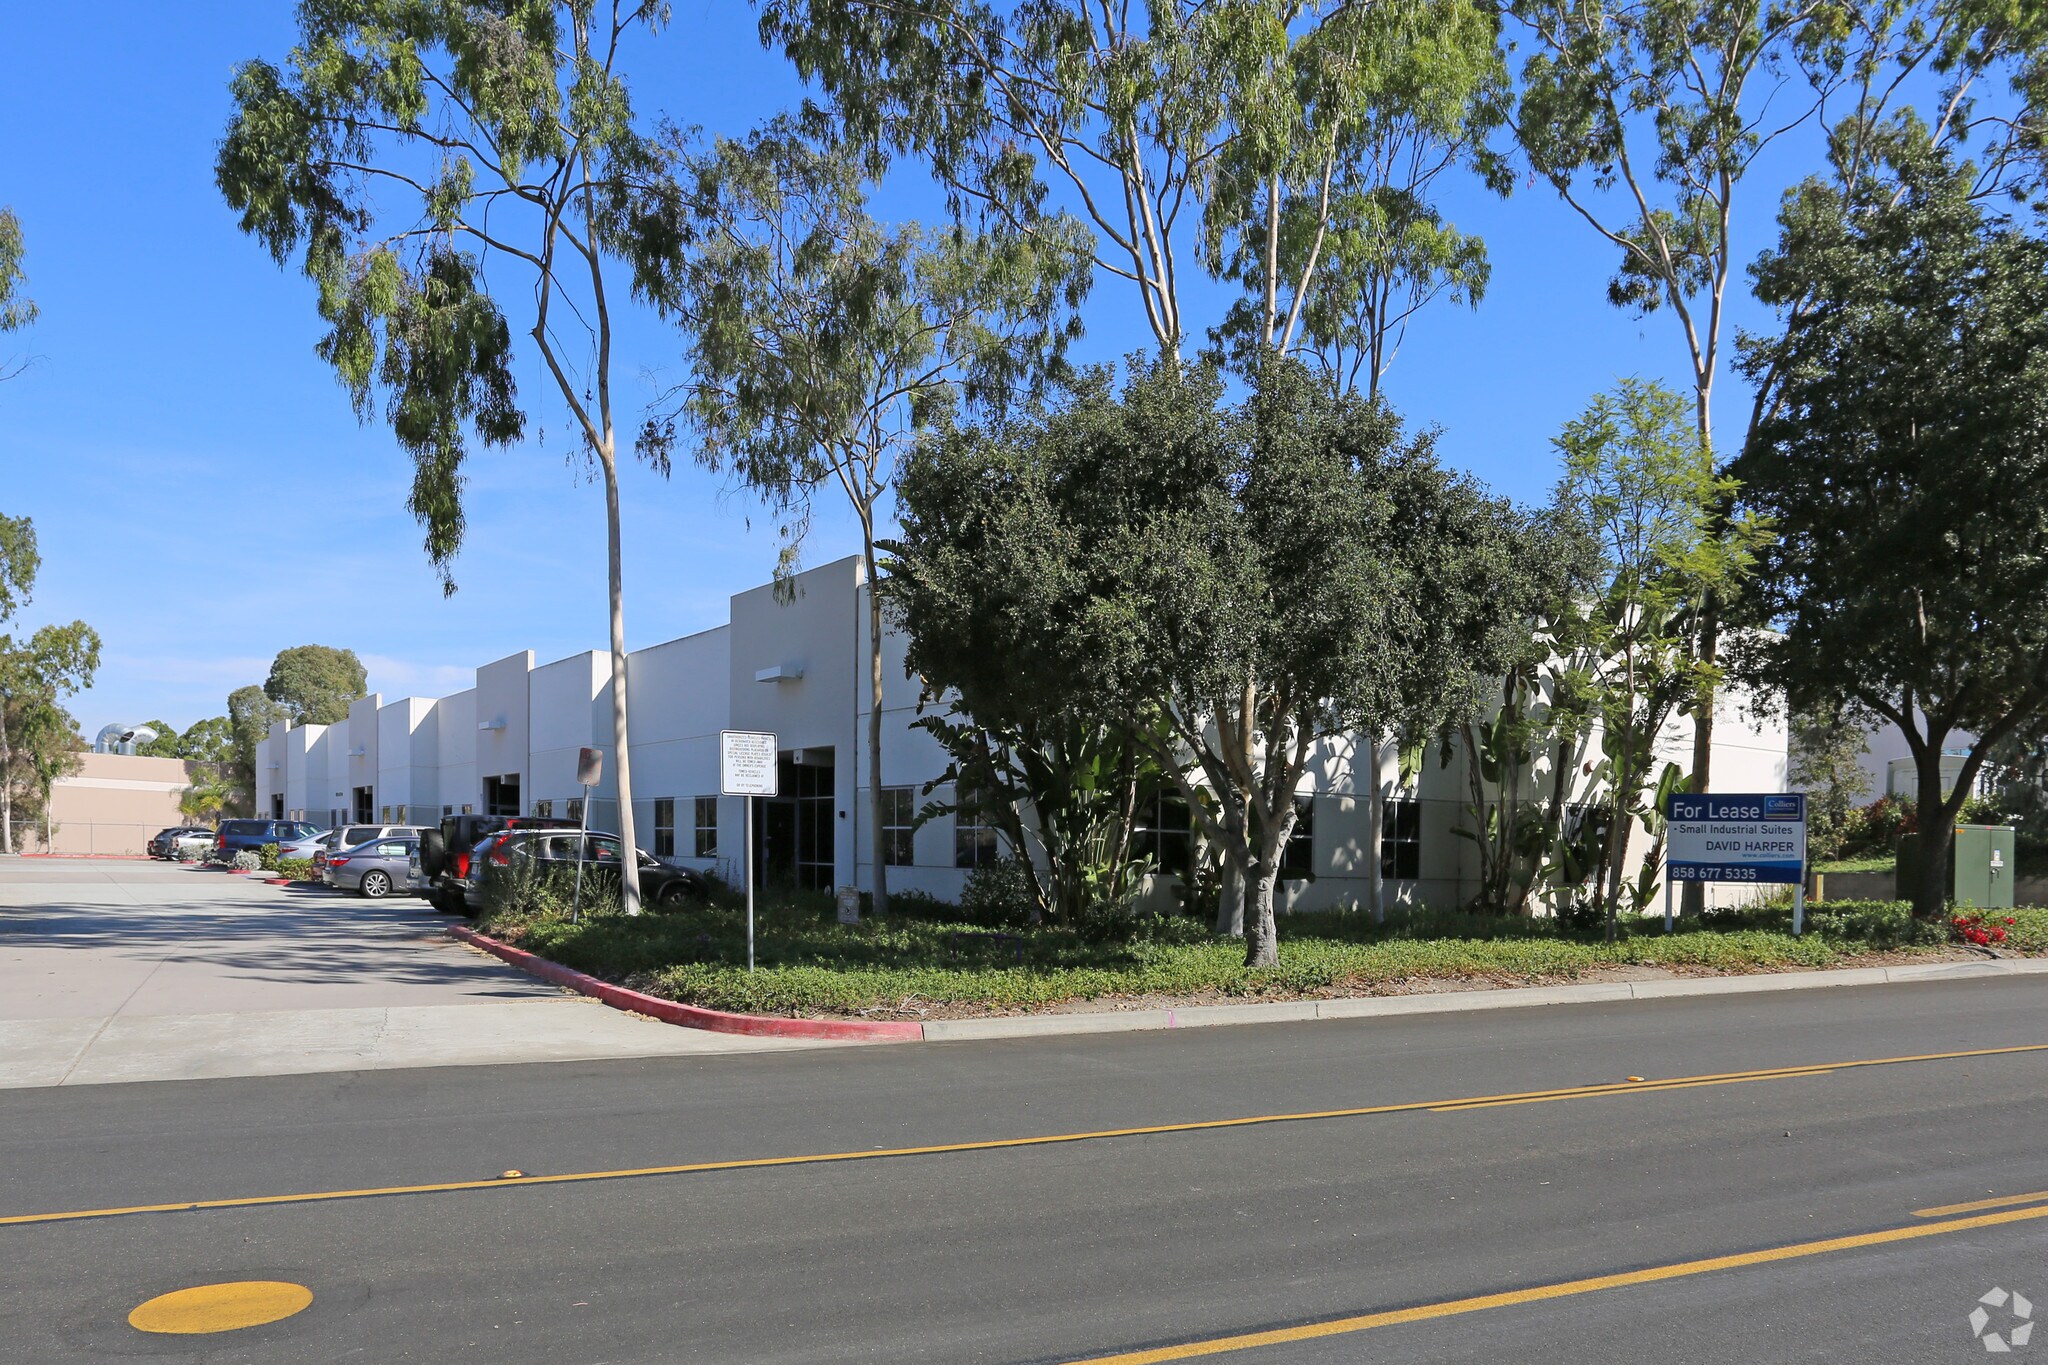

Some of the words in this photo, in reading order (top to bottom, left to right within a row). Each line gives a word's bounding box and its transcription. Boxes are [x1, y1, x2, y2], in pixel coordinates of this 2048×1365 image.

[1768, 799, 1796, 808] Colliers
[1673, 802, 1702, 819] For
[1708, 802, 1760, 819] Lease
[1679, 824, 1707, 834] Small
[1710, 824, 1757, 835] Industrial
[1760, 824, 1793, 835] Suites
[1706, 841, 1741, 851] DAVID
[1744, 841, 1794, 852] HARPER
[1672, 867, 1695, 879] 858
[1699, 867, 1721, 879] 677
[1725, 868, 1757, 880] 5335
